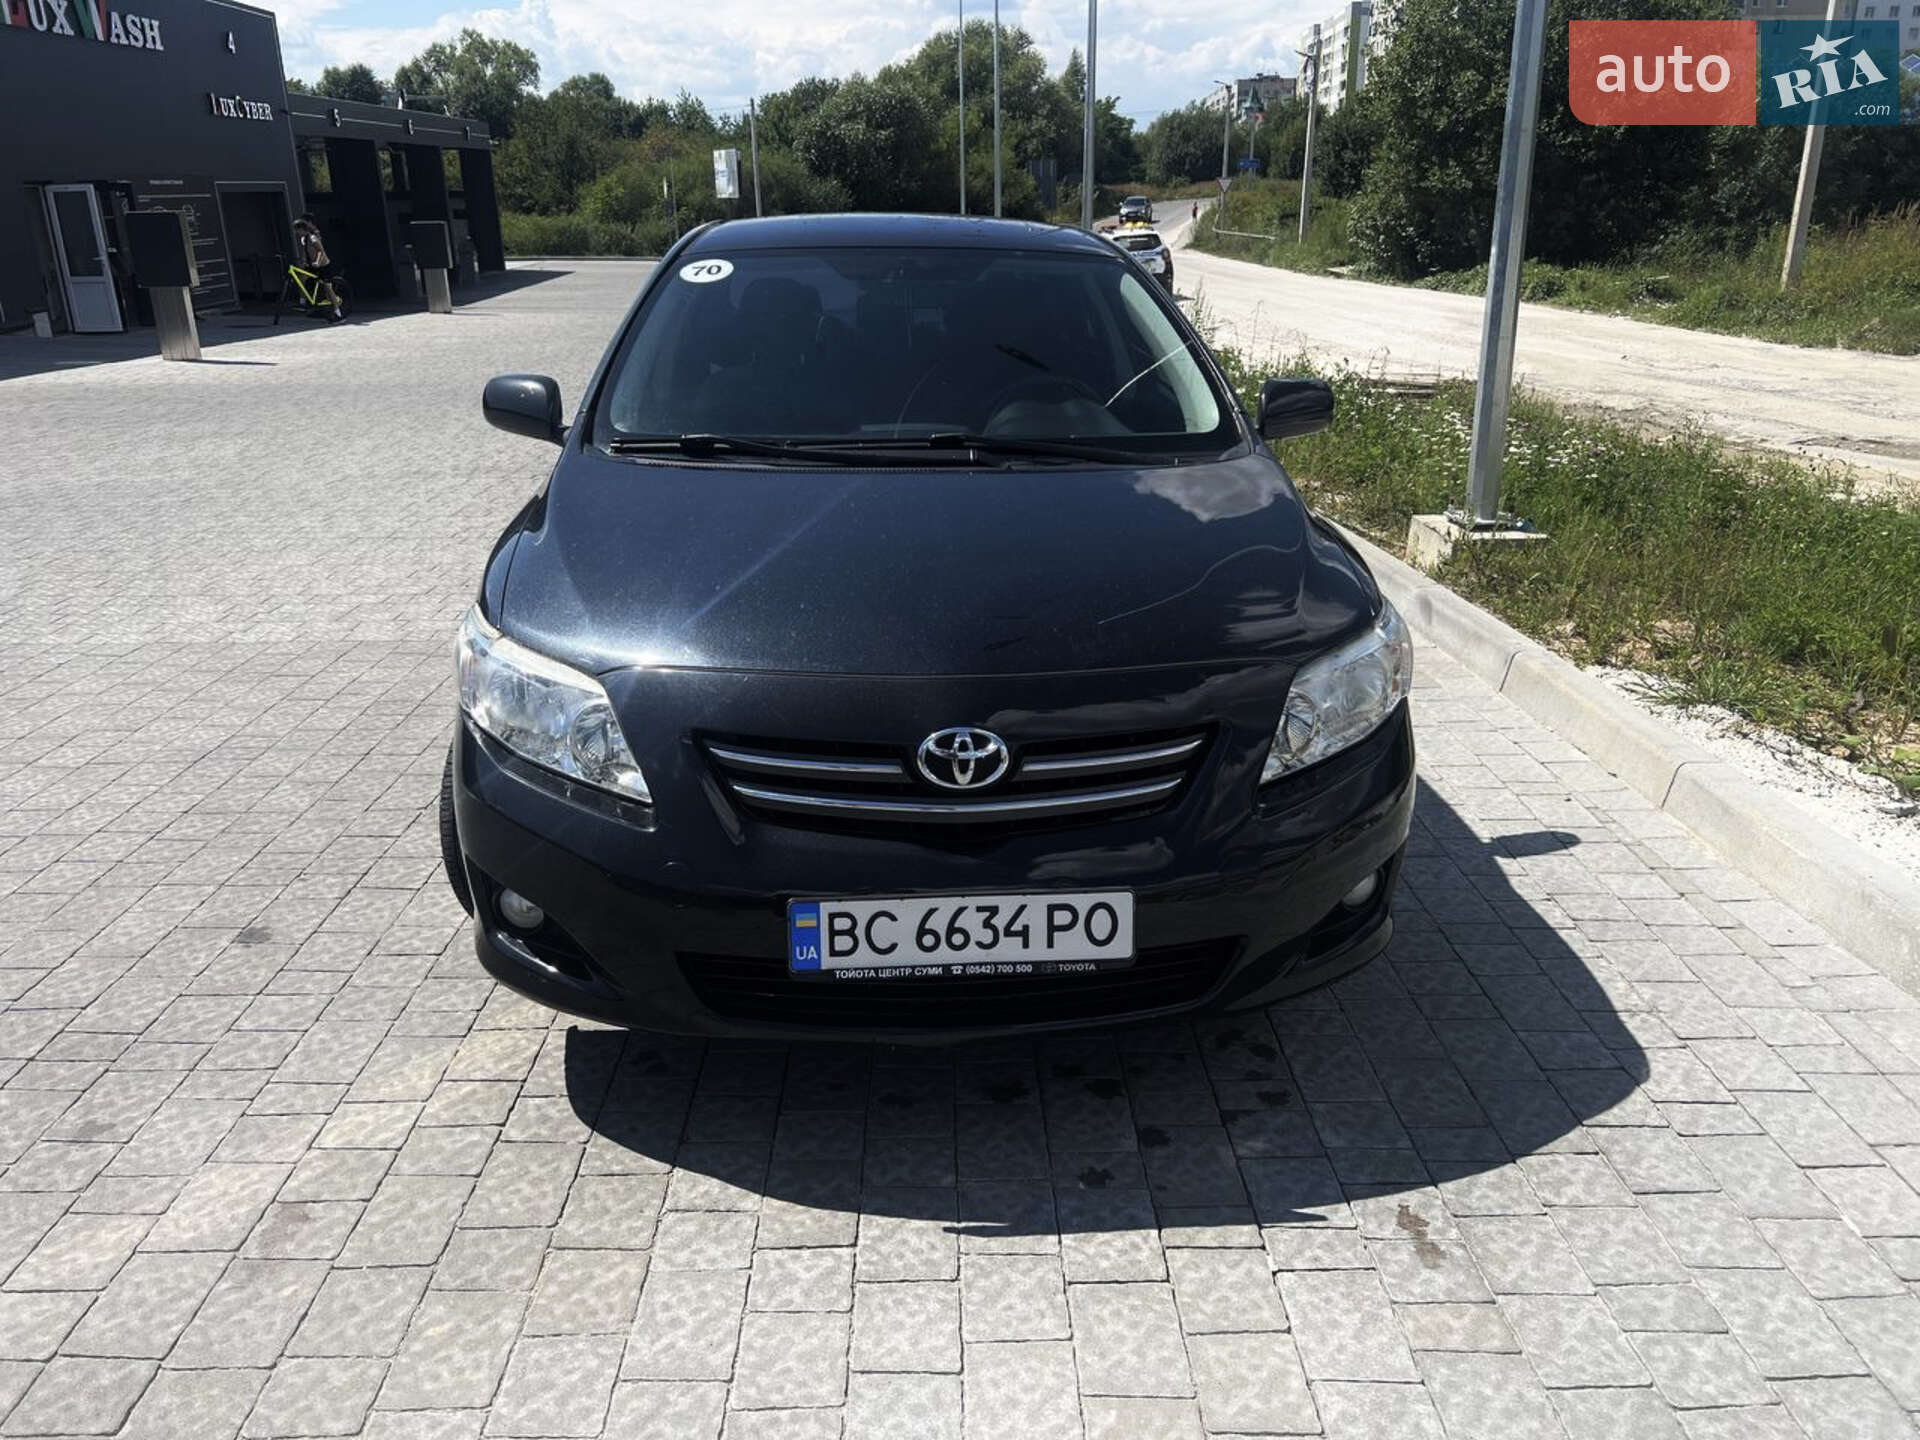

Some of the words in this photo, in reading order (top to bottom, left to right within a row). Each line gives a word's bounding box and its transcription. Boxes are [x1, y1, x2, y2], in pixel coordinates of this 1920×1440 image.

[228, 31, 236, 54] 4
[692, 264, 722, 276] 70
[827, 910, 899, 958] BC
[915, 904, 1030, 953] 6634
[1046, 901, 1119, 949] PO
[795, 946, 818, 961] UA
[879, 967, 912, 978] ЦЕНТР
[914, 966, 943, 976] СУМИ
[965, 963, 995, 975] (0542)
[996, 964, 1014, 974] 700
[1015, 963, 1033, 973] 500
[1059, 962, 1097, 972] TOYOTA
